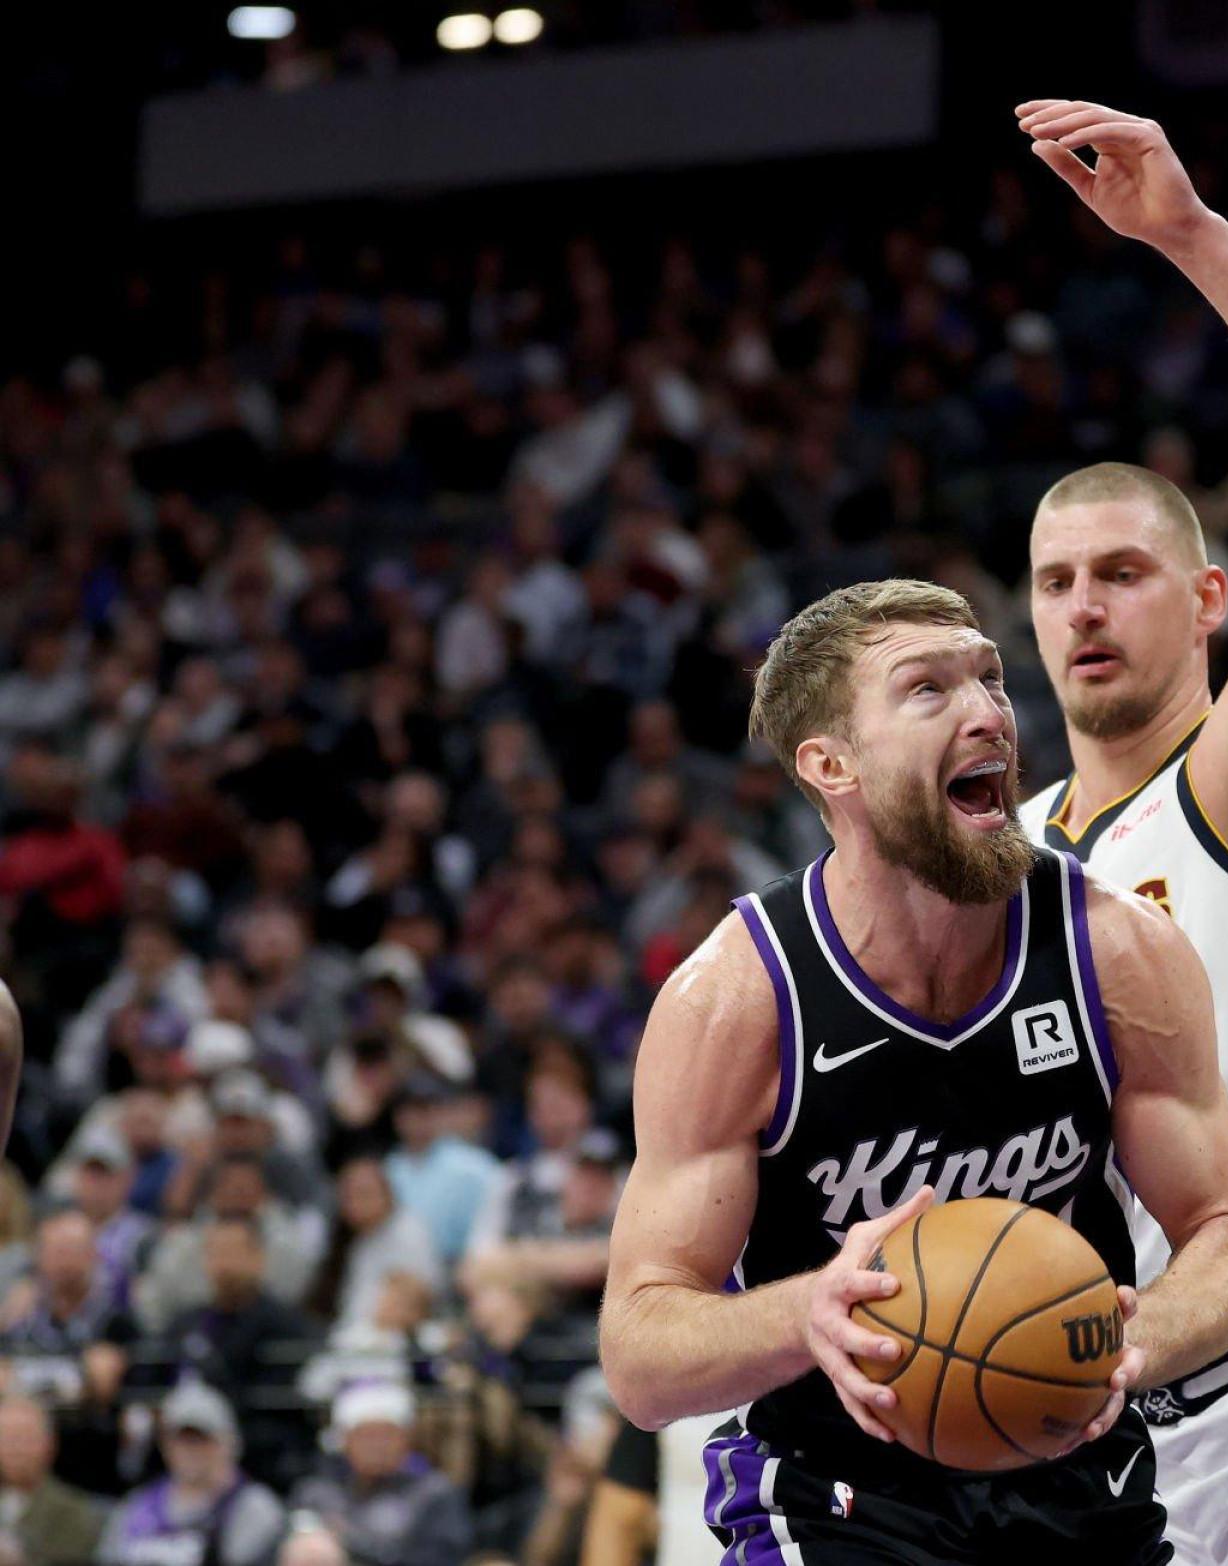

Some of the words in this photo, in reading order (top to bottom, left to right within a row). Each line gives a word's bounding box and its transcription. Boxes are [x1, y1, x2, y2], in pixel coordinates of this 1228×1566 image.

[1024, 1012, 1063, 1049] R
[1022, 1047, 1075, 1068] REVIVER
[806, 1113, 1091, 1226] Kings
